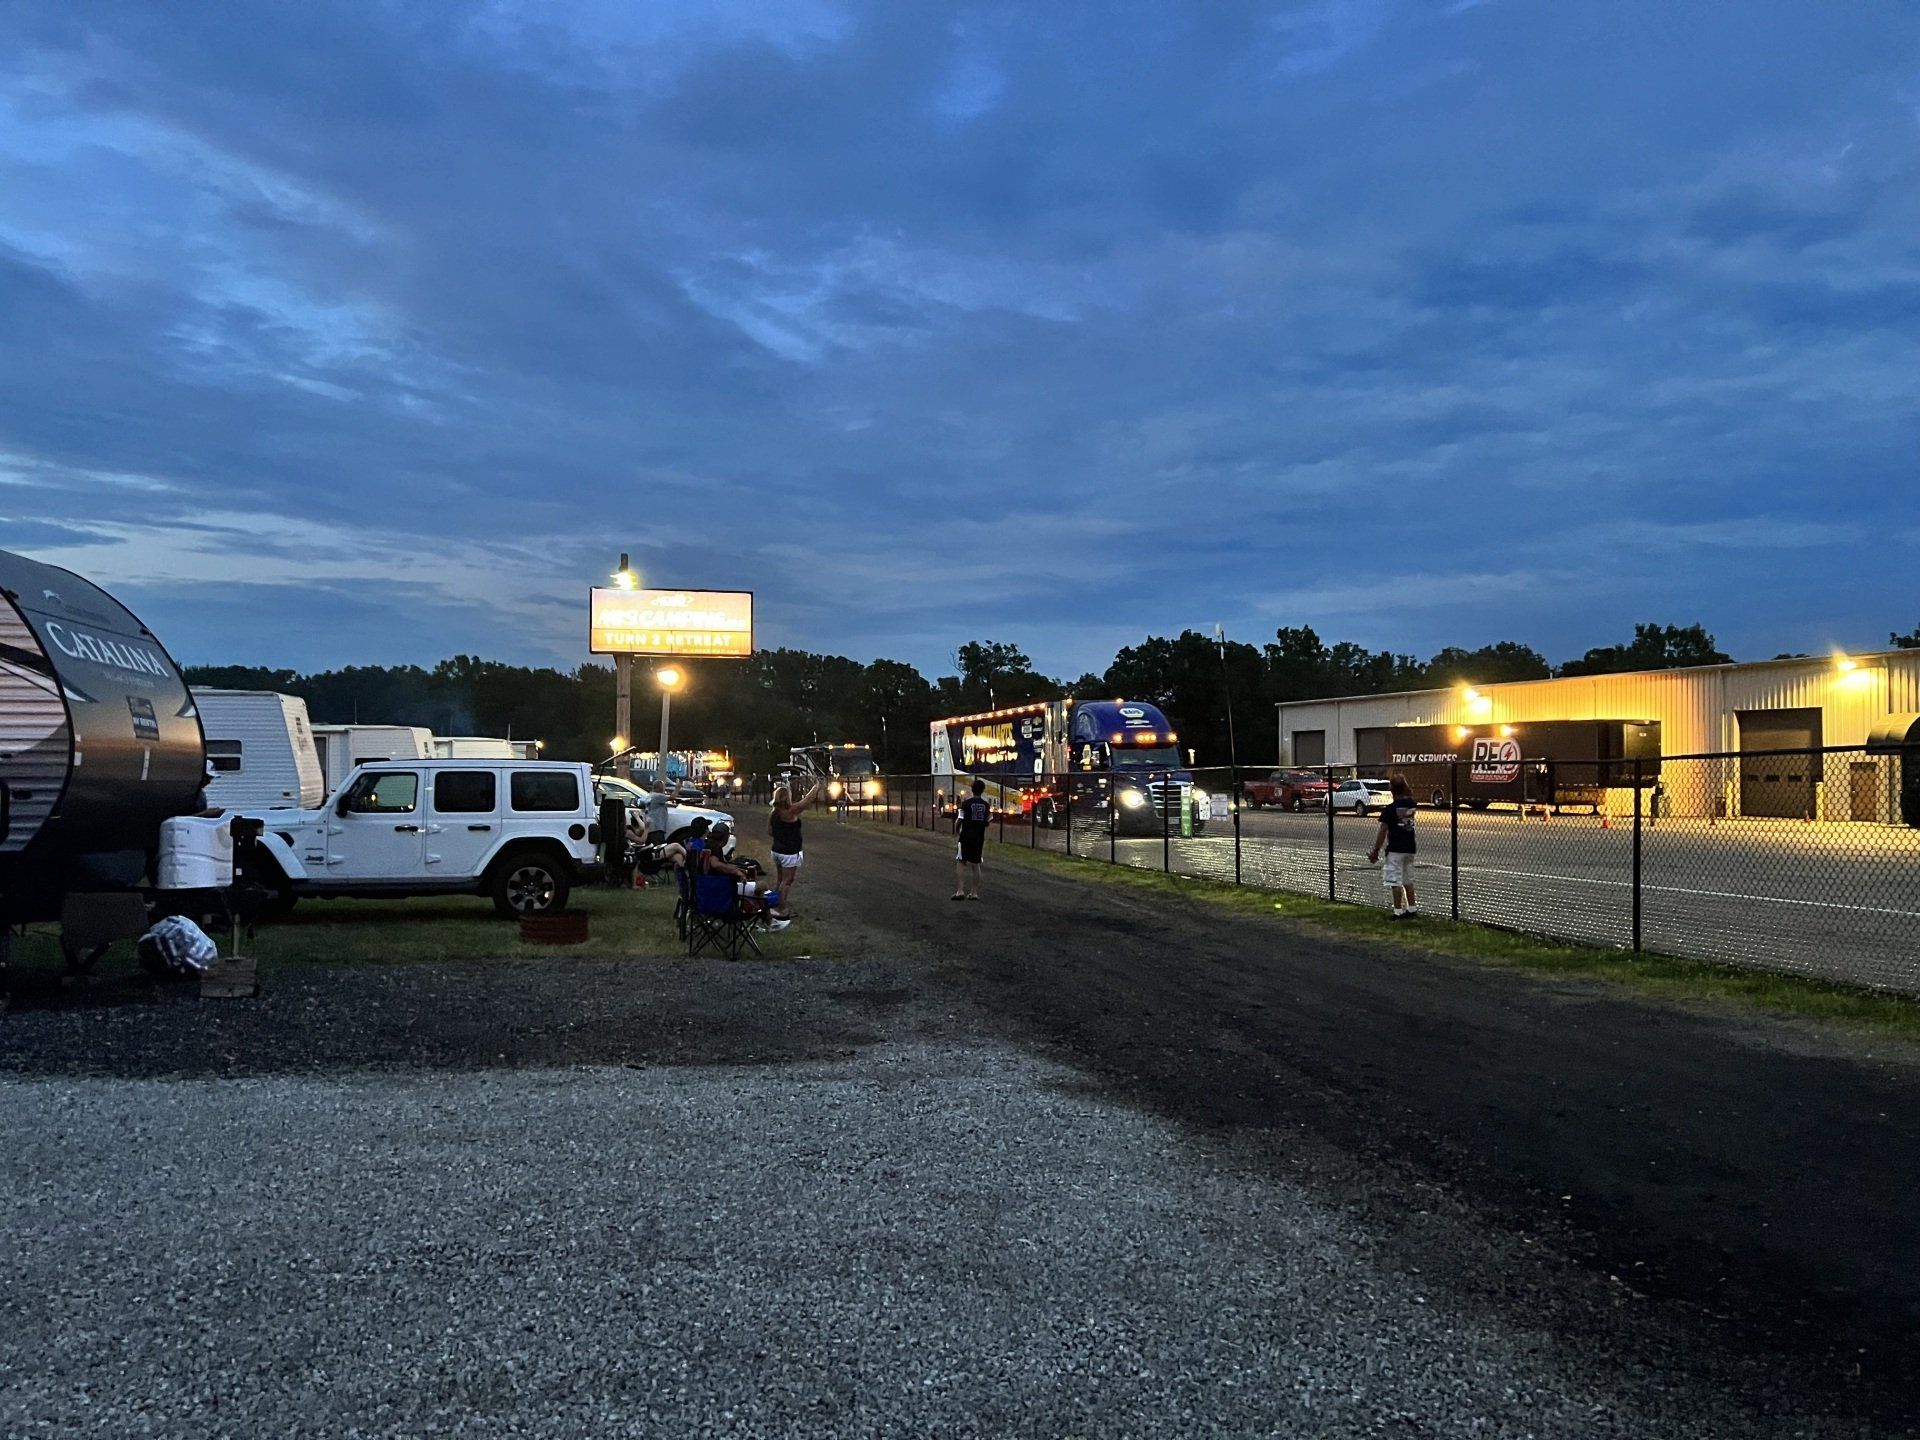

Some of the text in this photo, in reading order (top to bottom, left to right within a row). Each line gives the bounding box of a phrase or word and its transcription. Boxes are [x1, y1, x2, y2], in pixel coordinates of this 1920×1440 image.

[604, 632, 732, 648] TURN 2 RETREAT
[46, 621, 169, 677] CATALINA
[1392, 753, 1458, 764] TRACK SERVICES
[970, 802, 987, 821] 12
